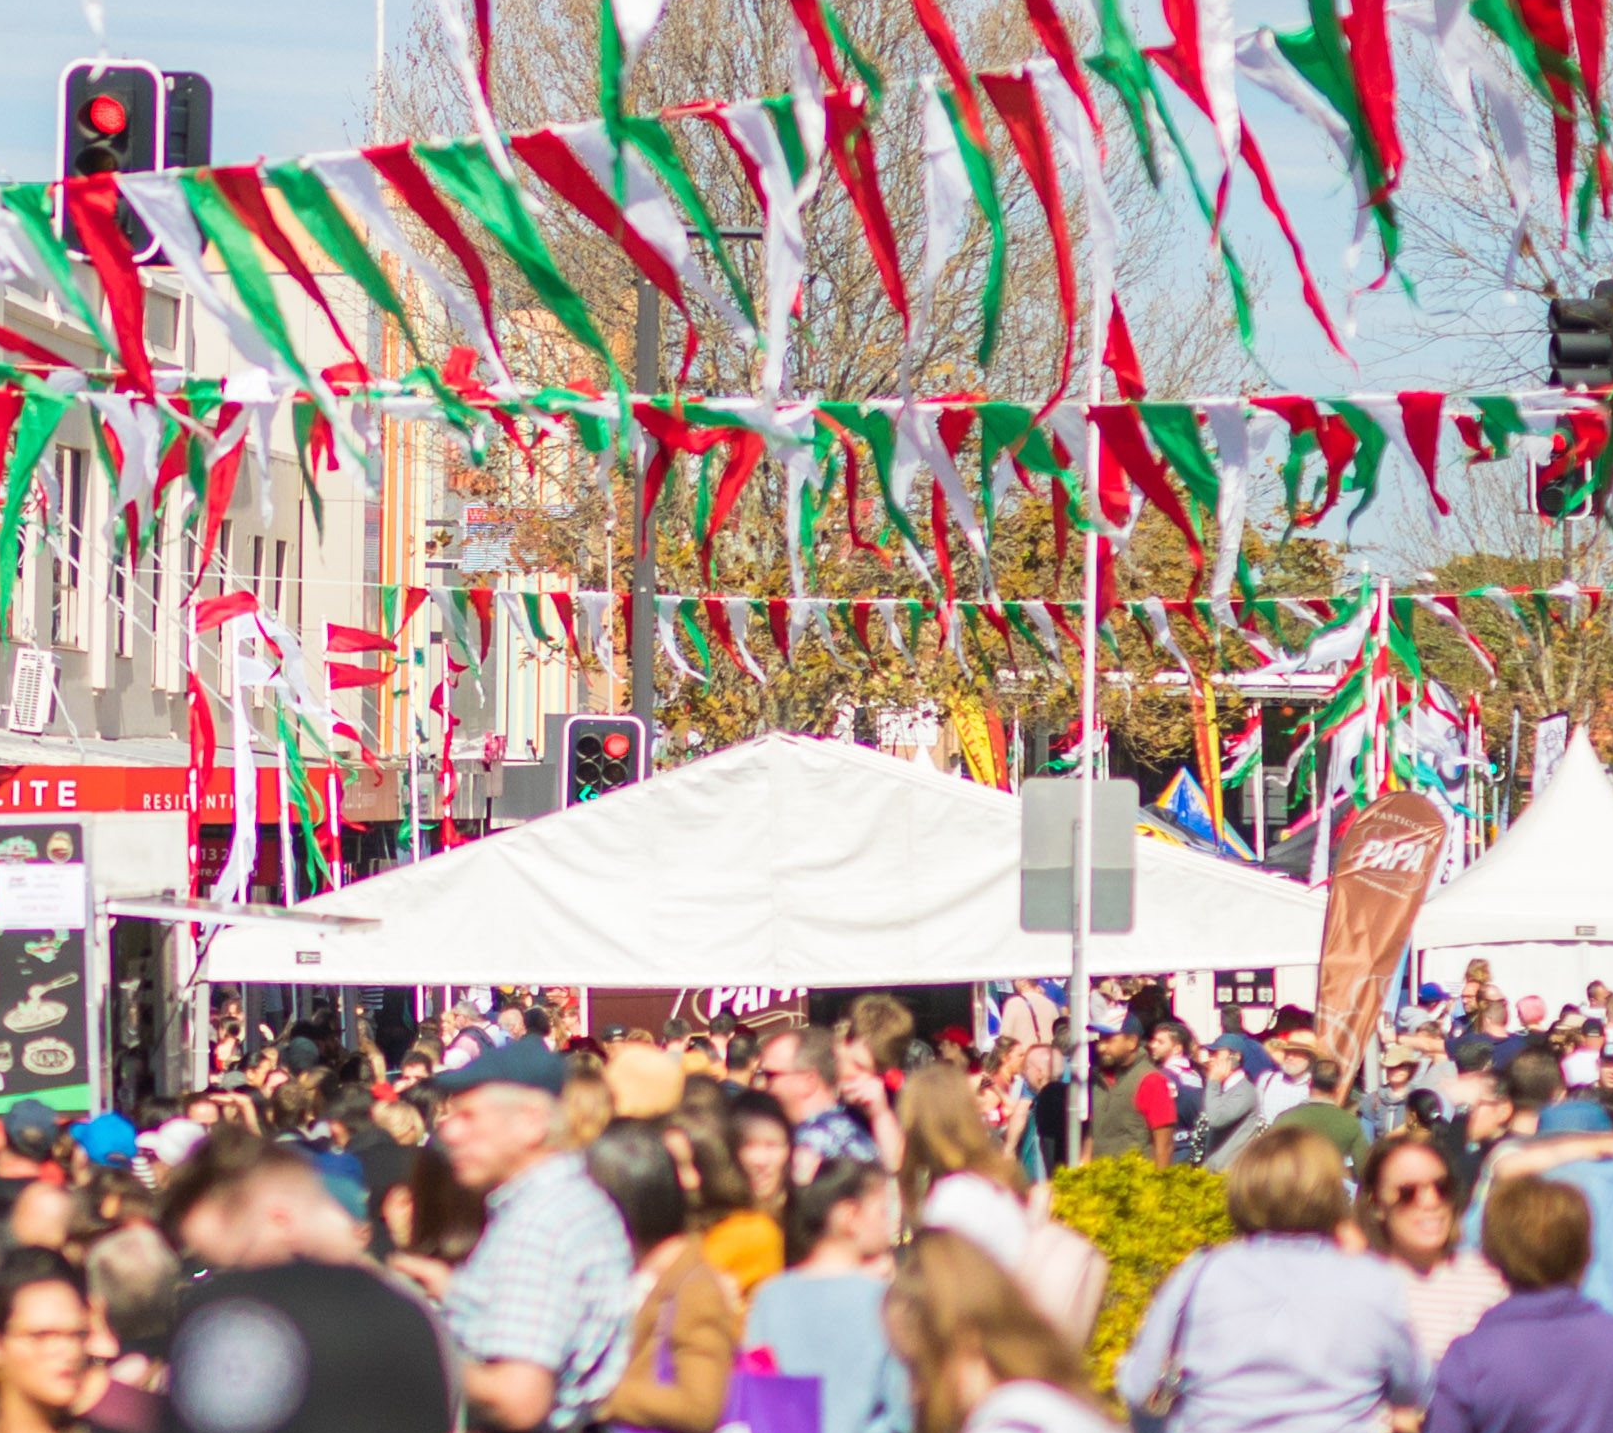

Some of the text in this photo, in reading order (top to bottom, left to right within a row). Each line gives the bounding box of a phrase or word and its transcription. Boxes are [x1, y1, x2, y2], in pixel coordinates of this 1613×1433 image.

[142, 793, 234, 811] RESIDNTI
[1354, 839, 1427, 873] PAPA
[708, 987, 808, 1019] PA
